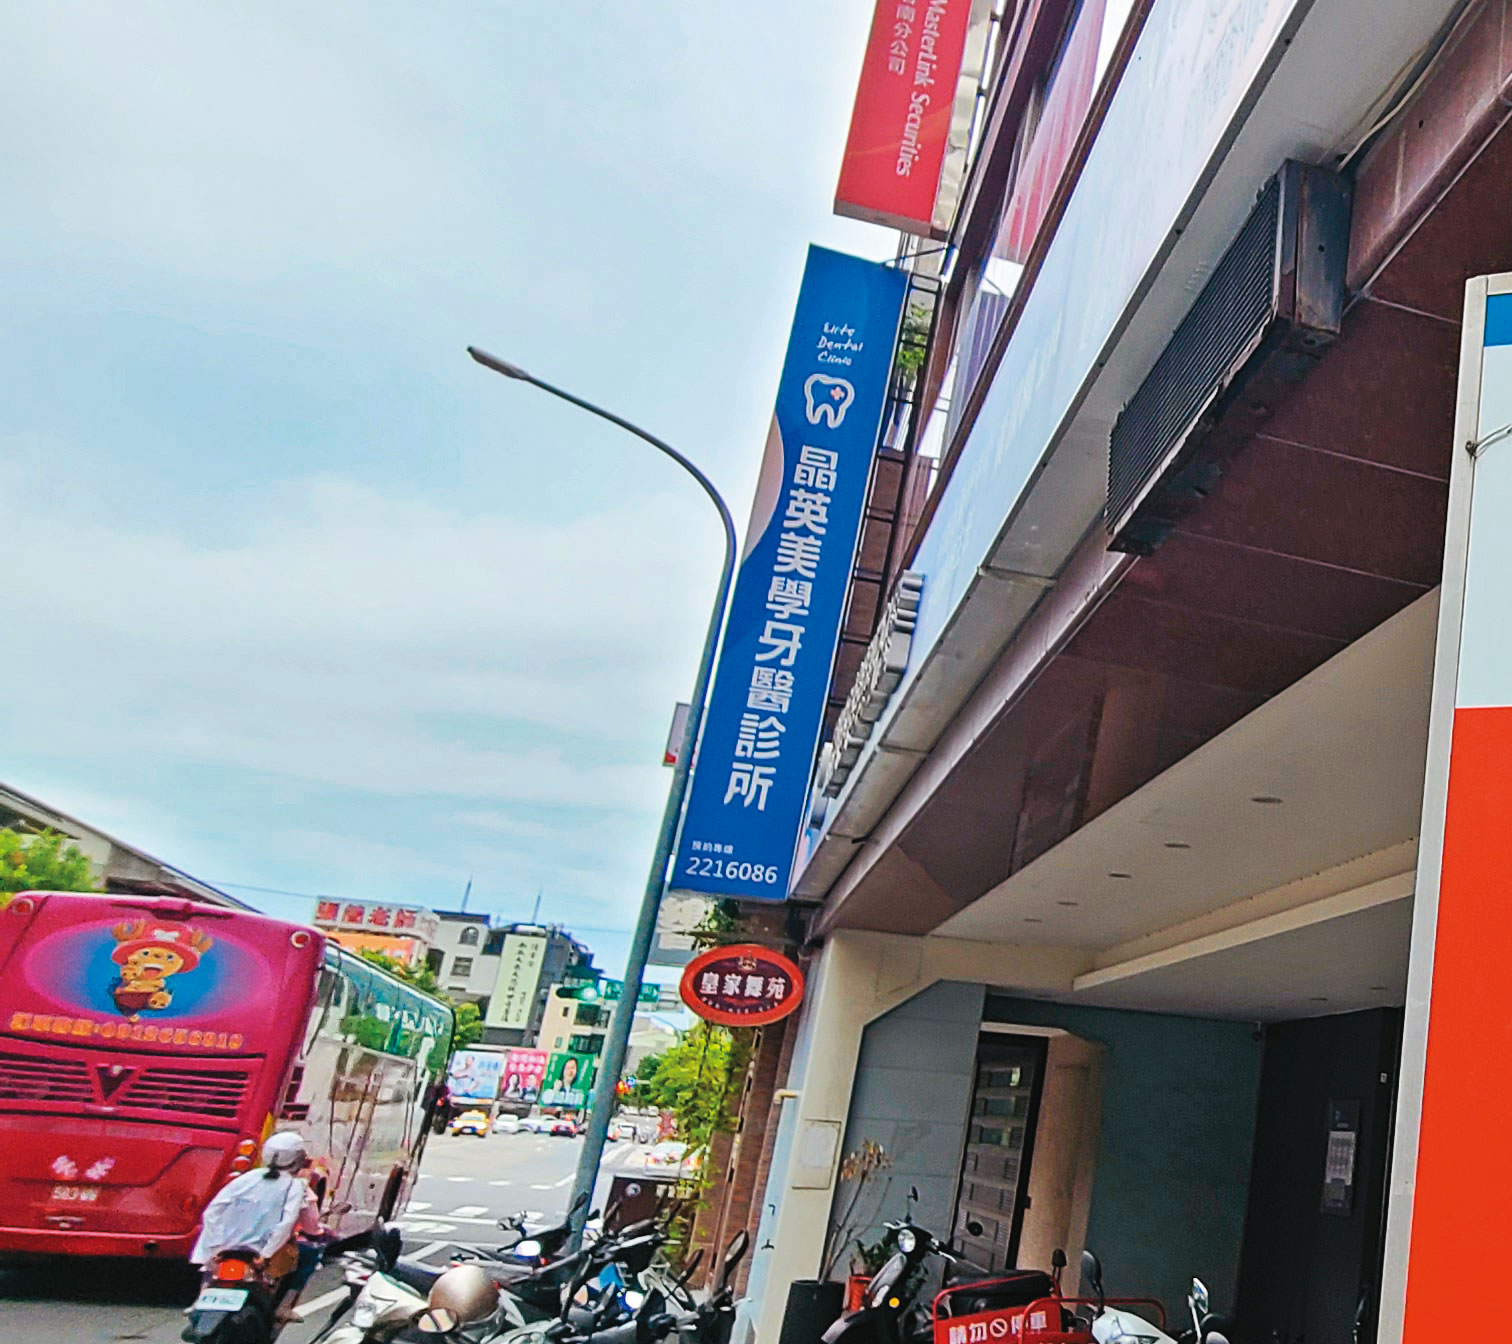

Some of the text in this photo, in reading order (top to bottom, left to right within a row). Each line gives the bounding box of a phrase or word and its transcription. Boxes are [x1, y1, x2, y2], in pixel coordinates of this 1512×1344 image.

[896, 91, 930, 176] Securities
[816, 335, 864, 353] Dental
[723, 445, 839, 812] 晶英美學牙醫診所
[686, 857, 779, 884] 2216086
[699, 971, 787, 1001] 皇家舞苑
